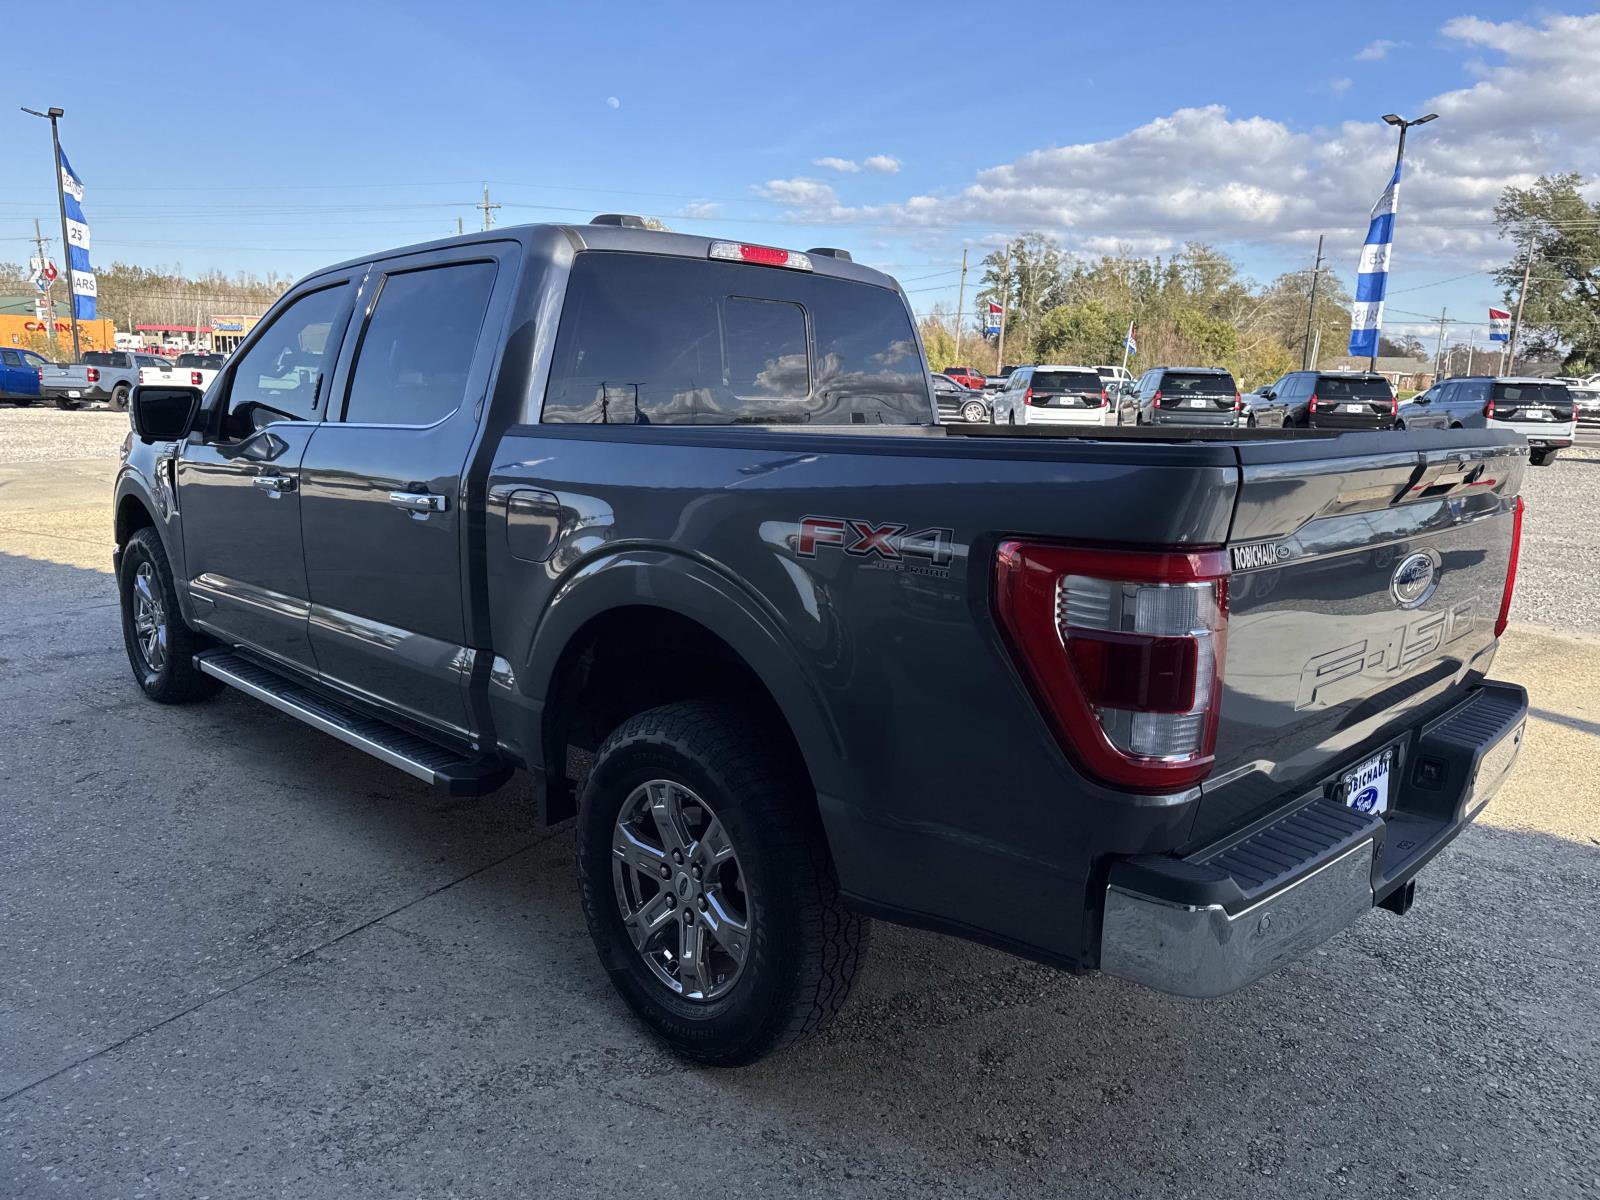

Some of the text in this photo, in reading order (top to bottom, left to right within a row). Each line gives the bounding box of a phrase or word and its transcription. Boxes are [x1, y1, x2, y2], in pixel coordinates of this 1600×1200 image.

[71, 228, 83, 241] 25
[24, 321, 84, 333] CAINO
[797, 514, 954, 568] FX4
[1234, 543, 1278, 570] ROBICHAUX
[1295, 595, 1481, 712] F-150
[1348, 760, 1389, 795] OBICHAUX
